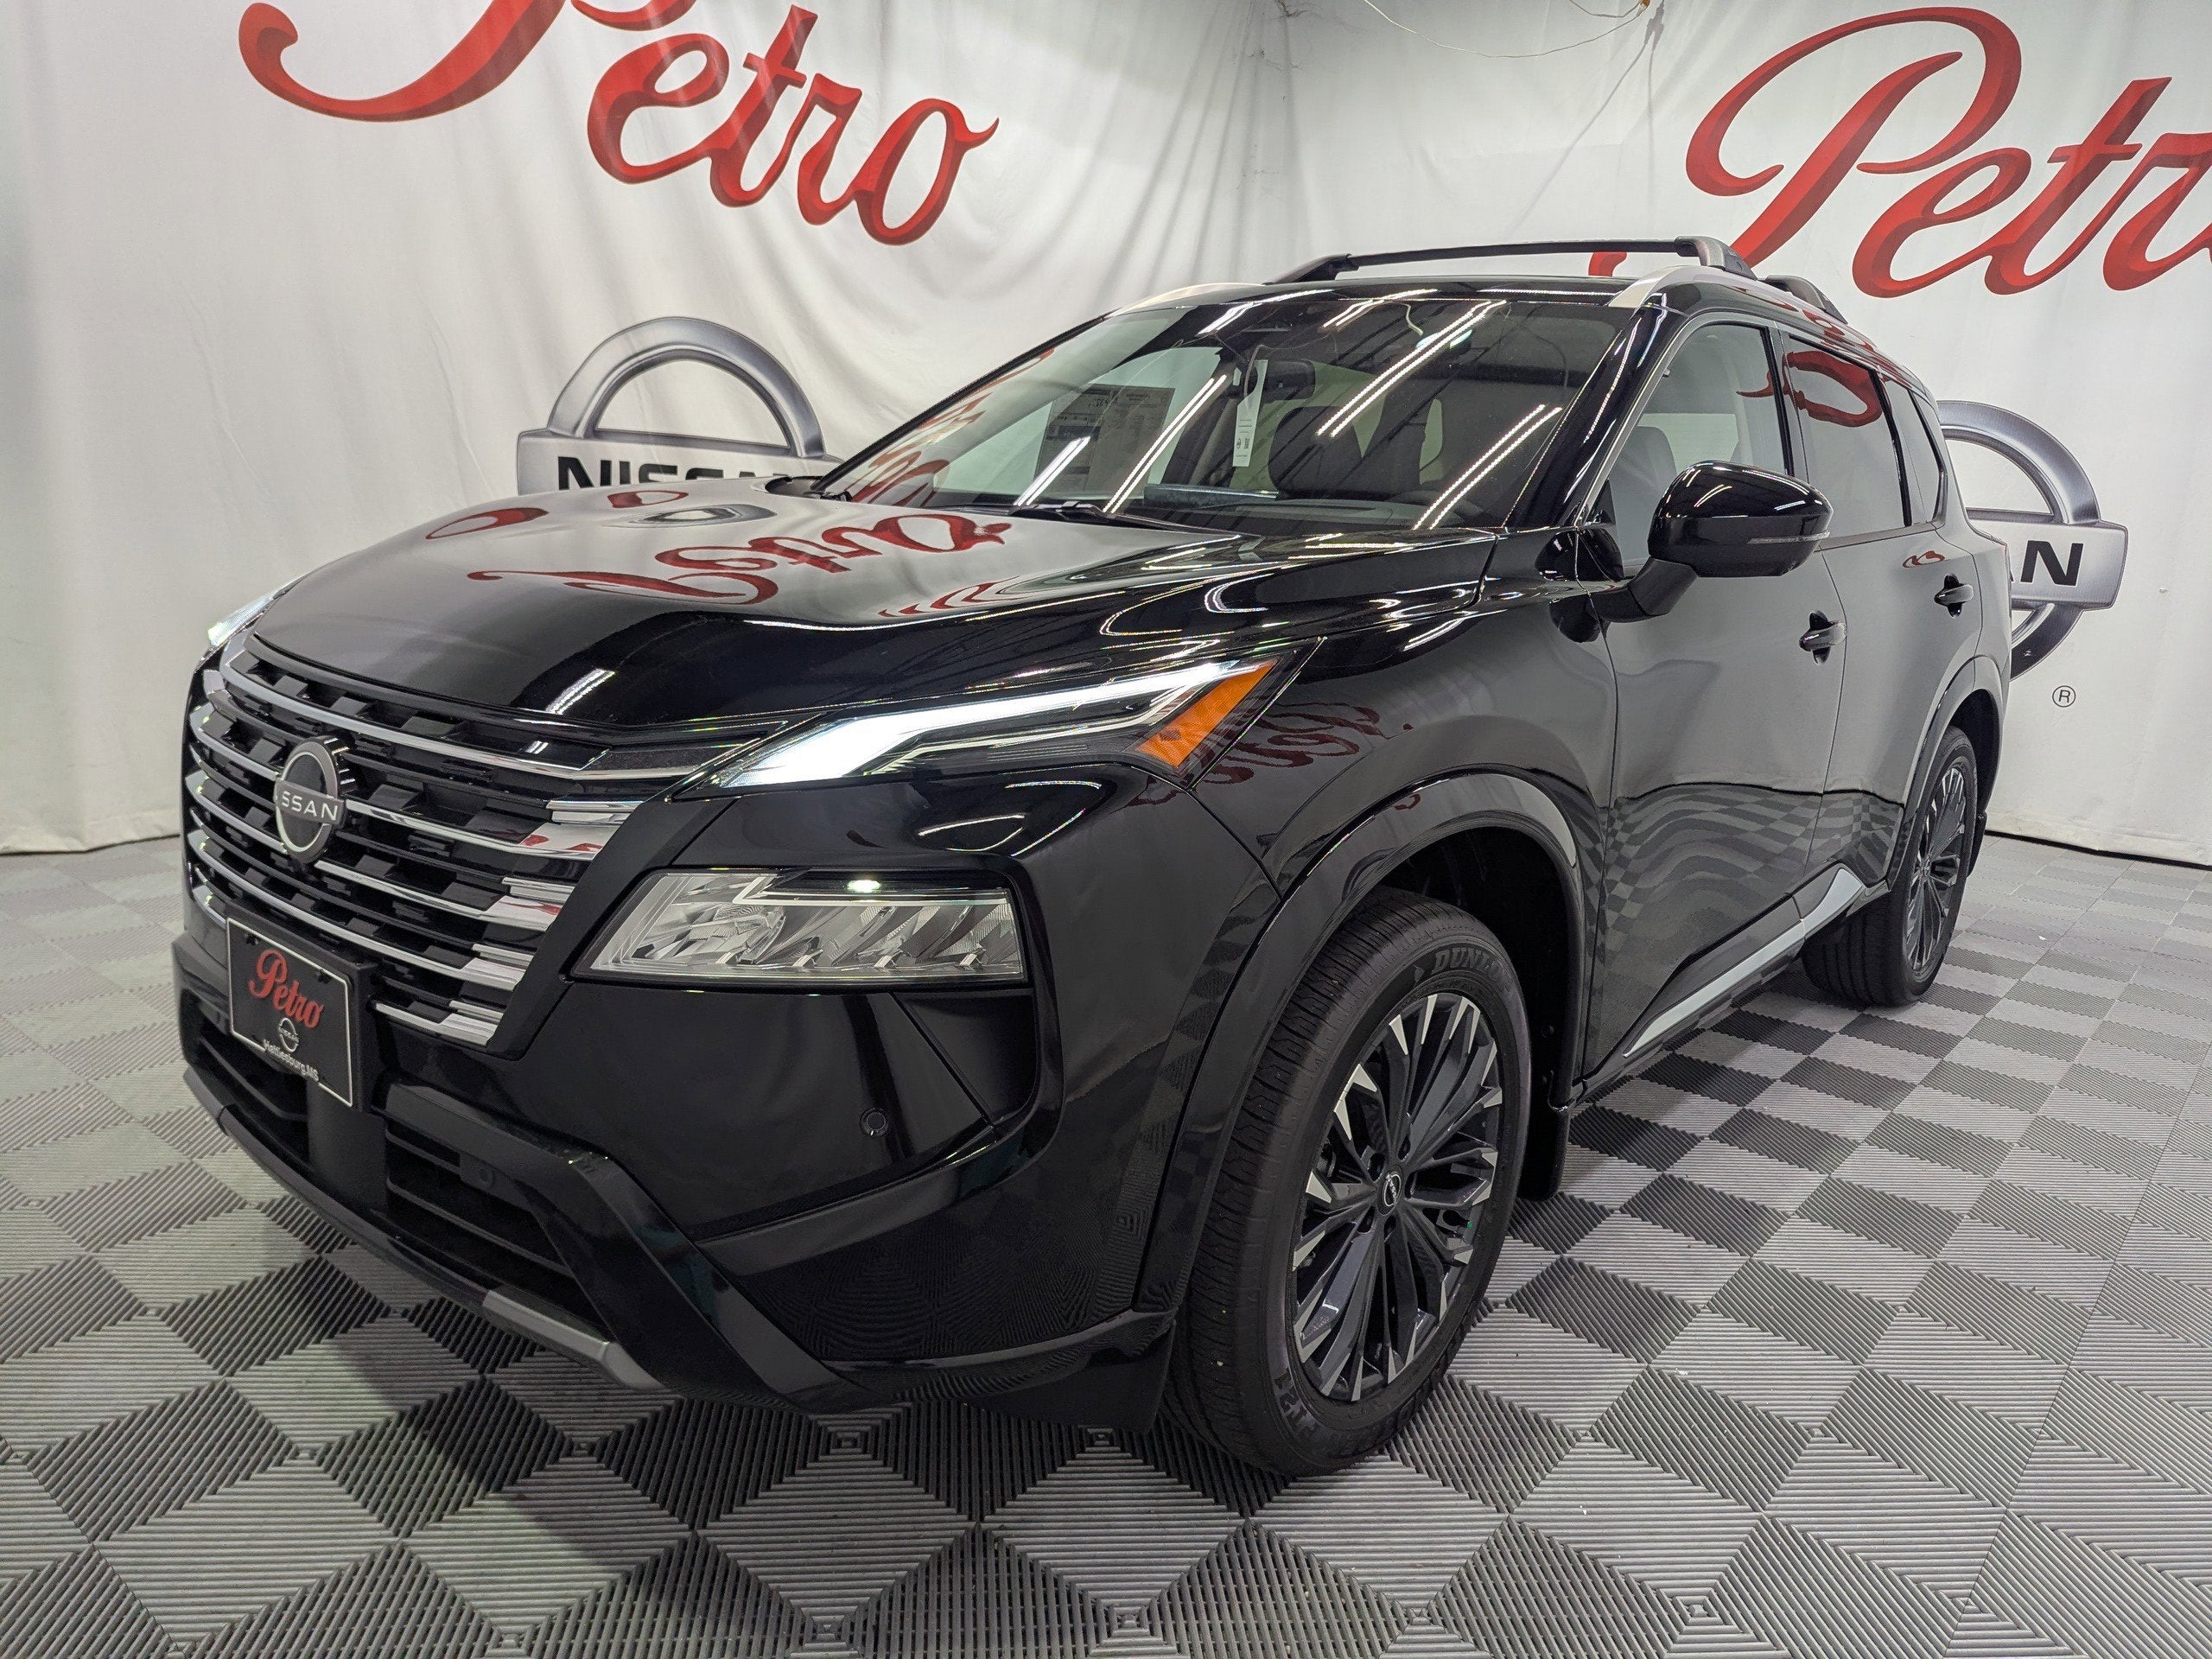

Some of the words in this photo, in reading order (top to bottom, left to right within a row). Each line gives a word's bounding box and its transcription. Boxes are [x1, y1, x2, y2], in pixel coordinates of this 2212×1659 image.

[1588, 7, 2212, 298] Petr
[281, 790, 339, 821] SSAN
[247, 949, 324, 1029] Petro
